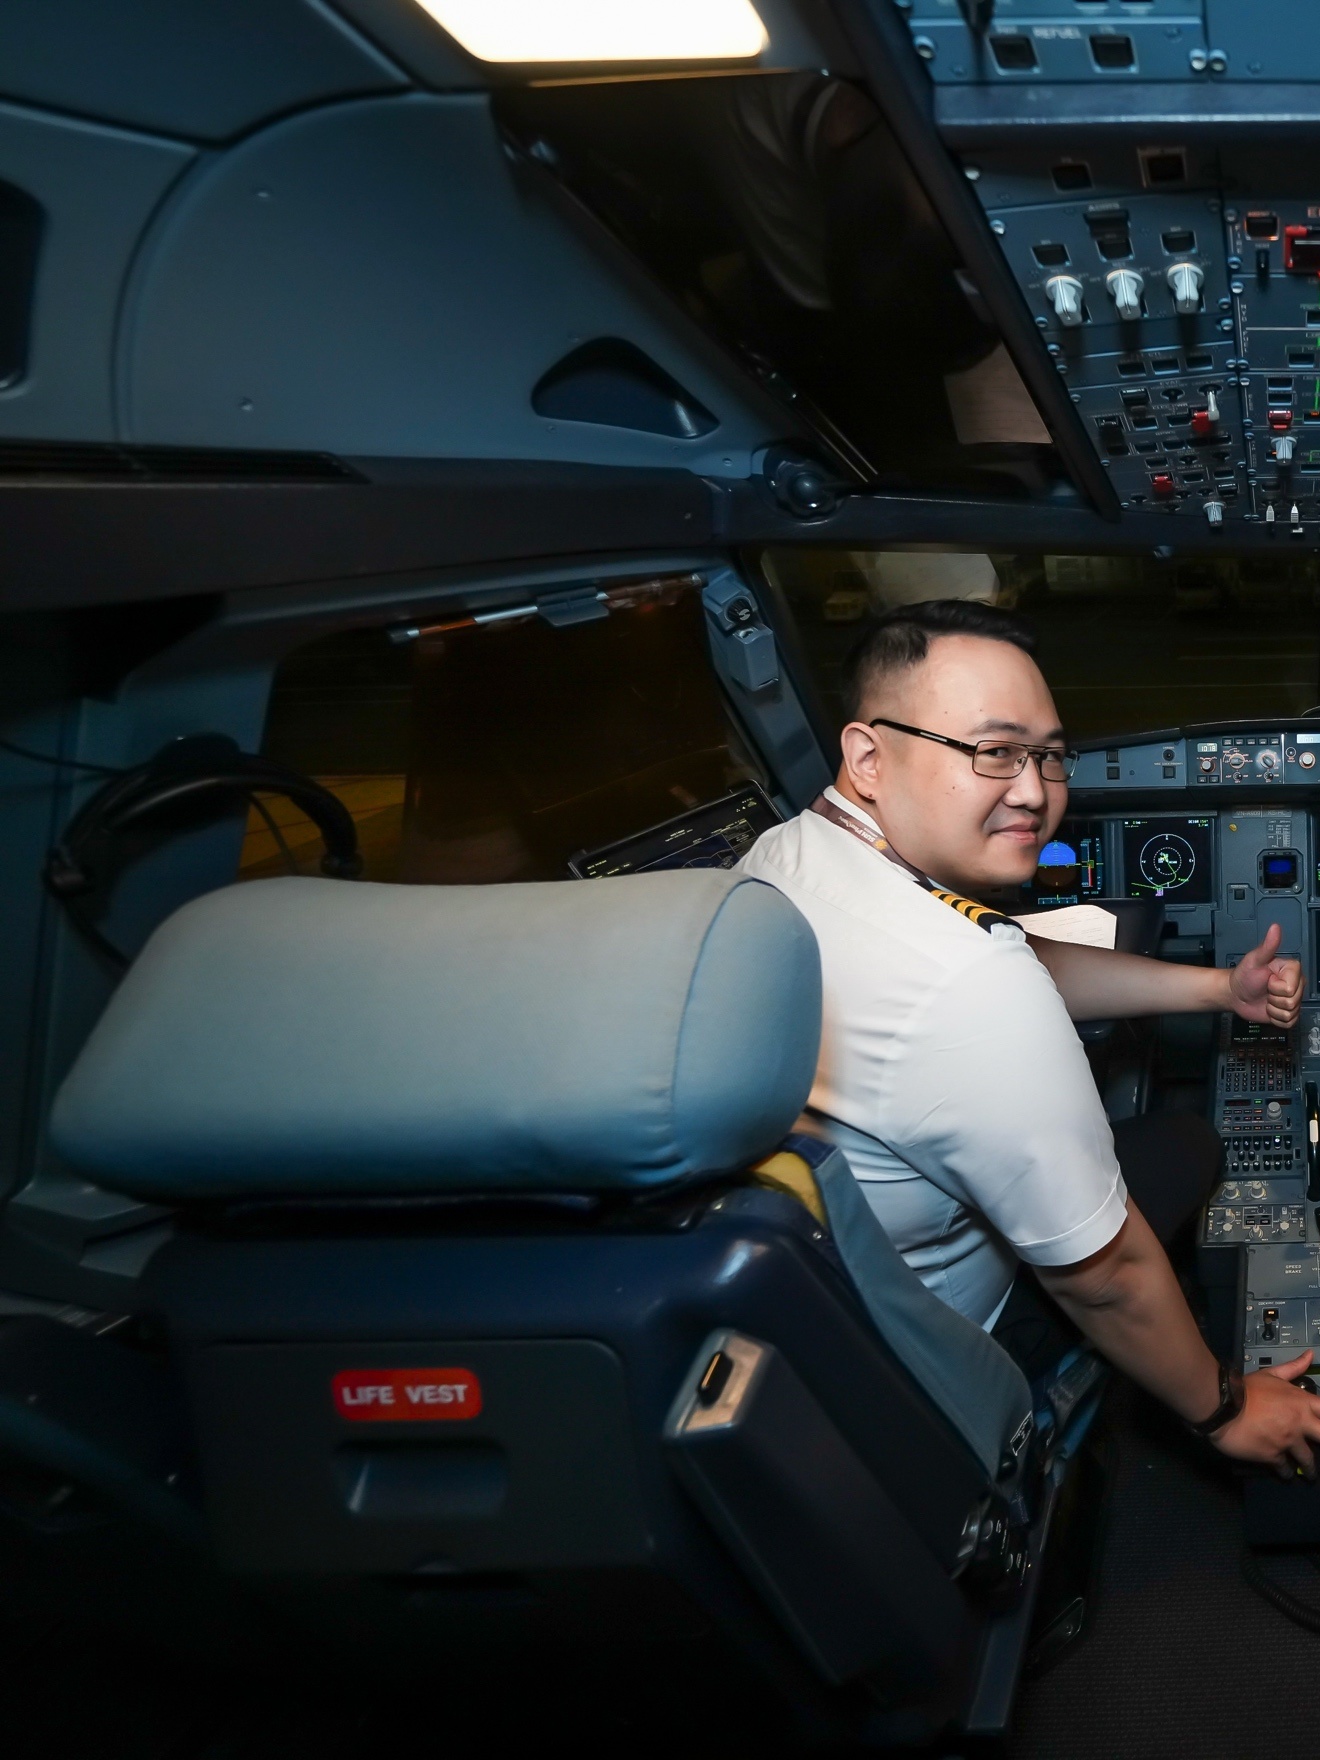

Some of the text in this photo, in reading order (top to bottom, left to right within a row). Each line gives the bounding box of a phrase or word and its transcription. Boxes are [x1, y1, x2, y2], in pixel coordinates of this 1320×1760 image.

[1032, 26, 1082, 40] REFUEL
[341, 1383, 469, 1406] LIFE VEST
